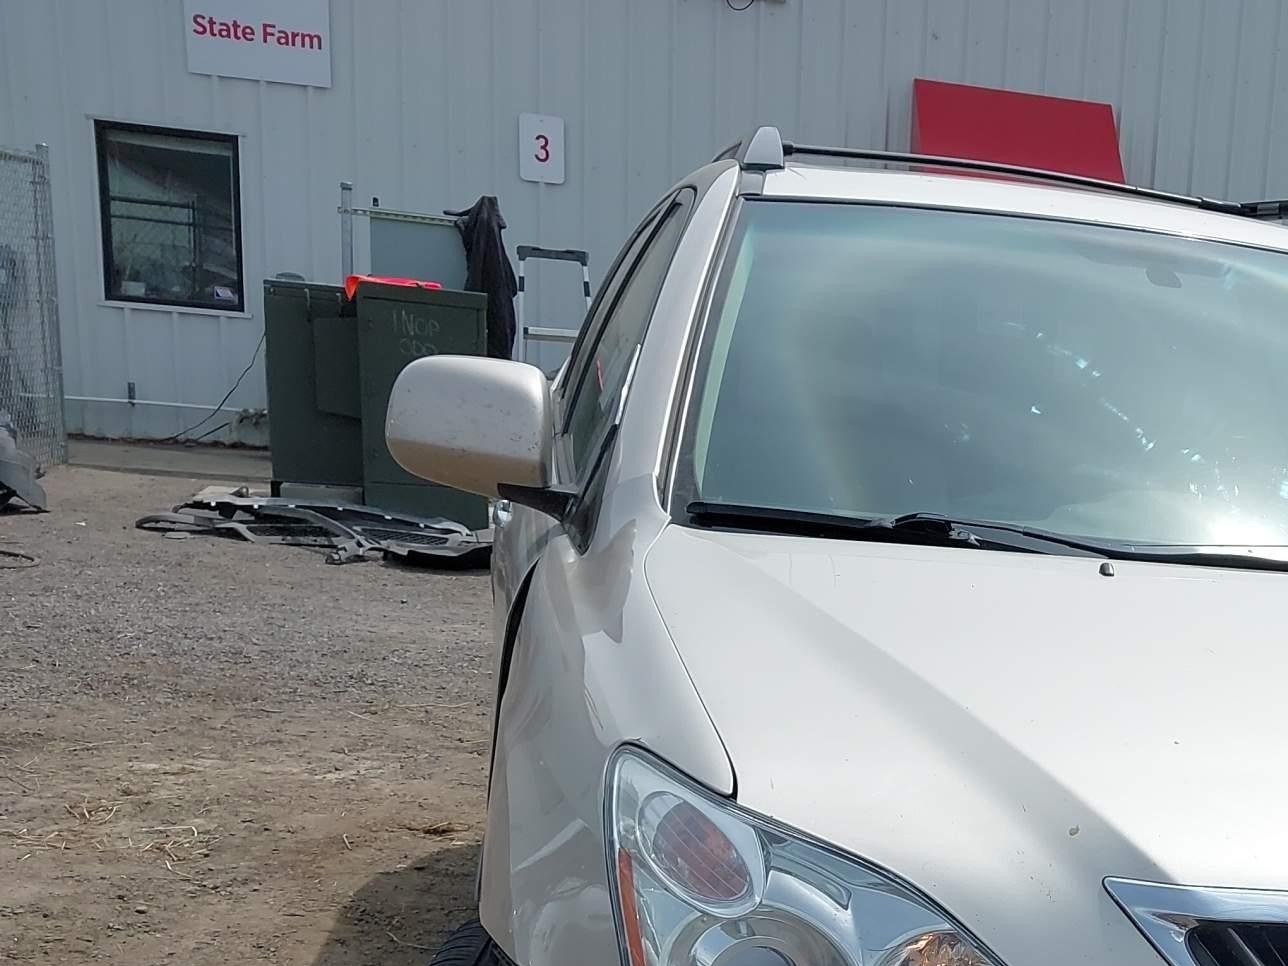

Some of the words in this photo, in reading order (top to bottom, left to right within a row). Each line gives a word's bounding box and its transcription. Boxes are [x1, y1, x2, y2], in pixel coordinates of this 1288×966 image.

[192, 14, 256, 42] State
[262, 23, 323, 50] Farm
[534, 134, 550, 163] 3
